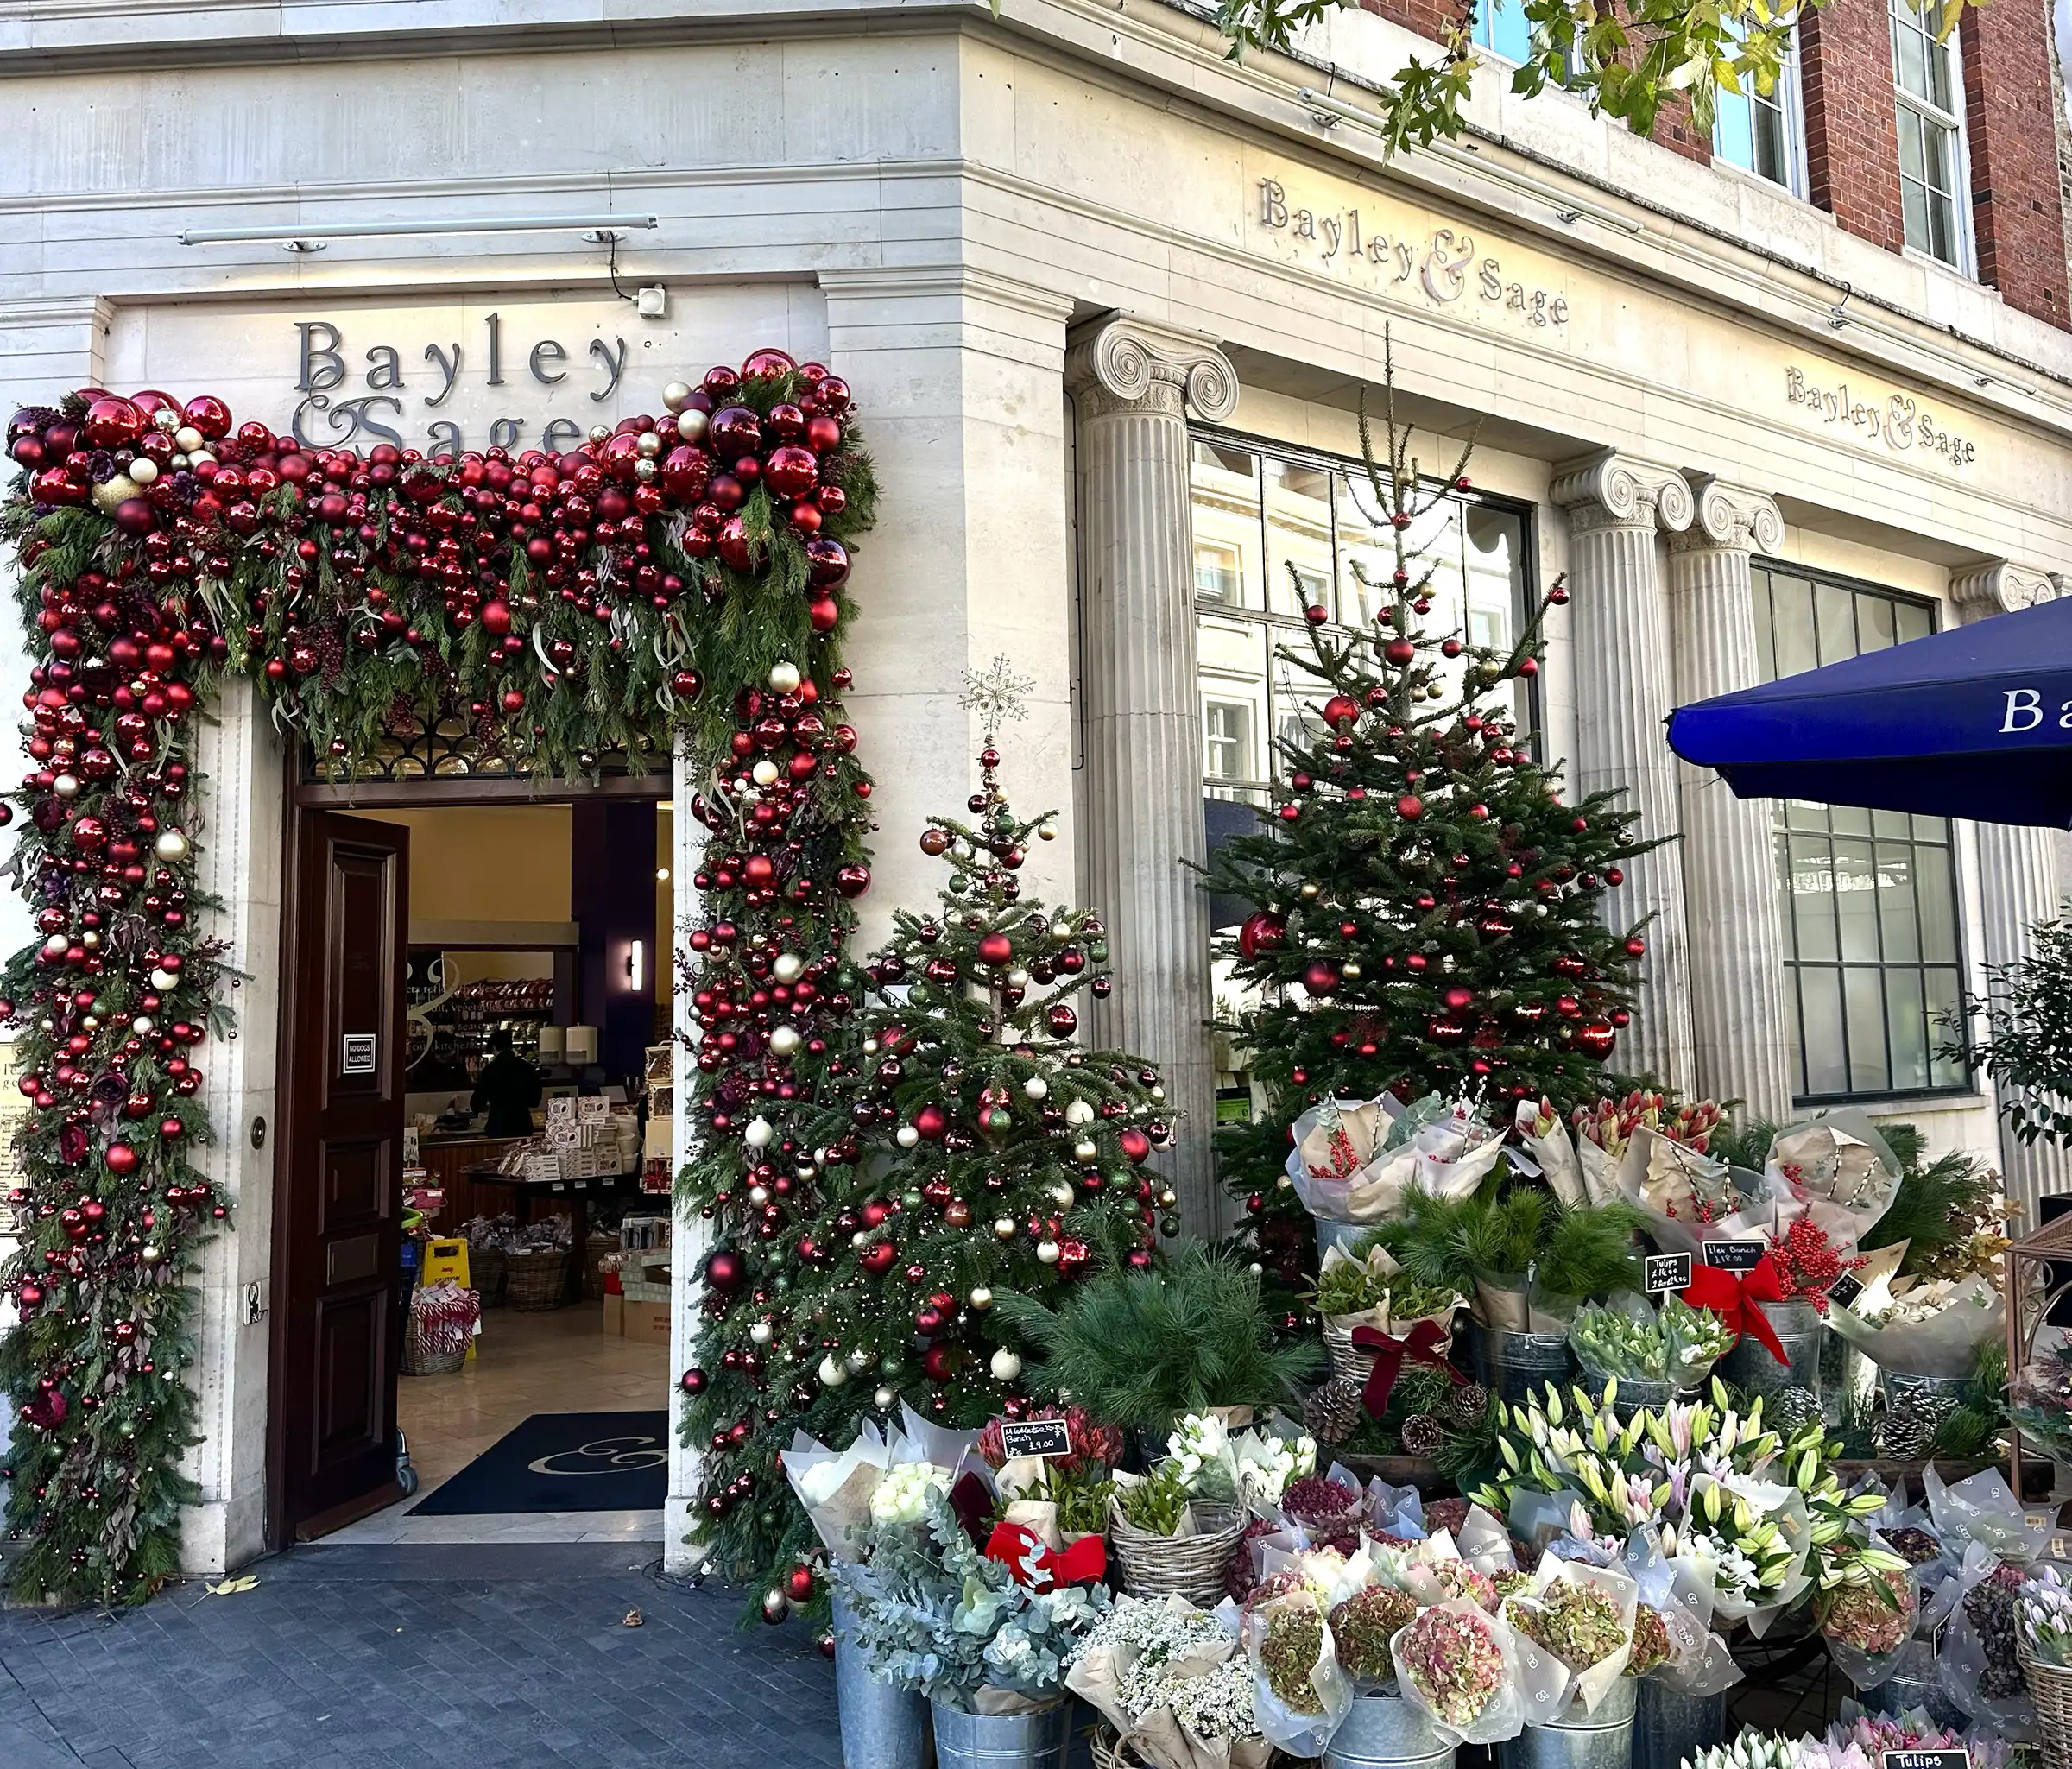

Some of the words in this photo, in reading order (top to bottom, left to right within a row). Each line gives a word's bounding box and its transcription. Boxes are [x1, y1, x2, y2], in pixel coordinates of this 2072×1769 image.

[1260, 177, 1413, 282] Bayley
[1421, 229, 1475, 301] &
[1480, 258, 1569, 327] Sage
[293, 312, 626, 407] Bayley
[1787, 365, 1880, 438] Bayley
[1884, 394, 1916, 450] &
[1918, 414, 1974, 466] Sage
[1707, 1244, 1726, 1254] Ilex
[1653, 1258, 1678, 1268] Tulips
[1005, 1425, 1047, 1436] Mistletoe
[1028, 1439, 1054, 1451] £9.00
[1895, 1754, 1942, 1768] Tulips
